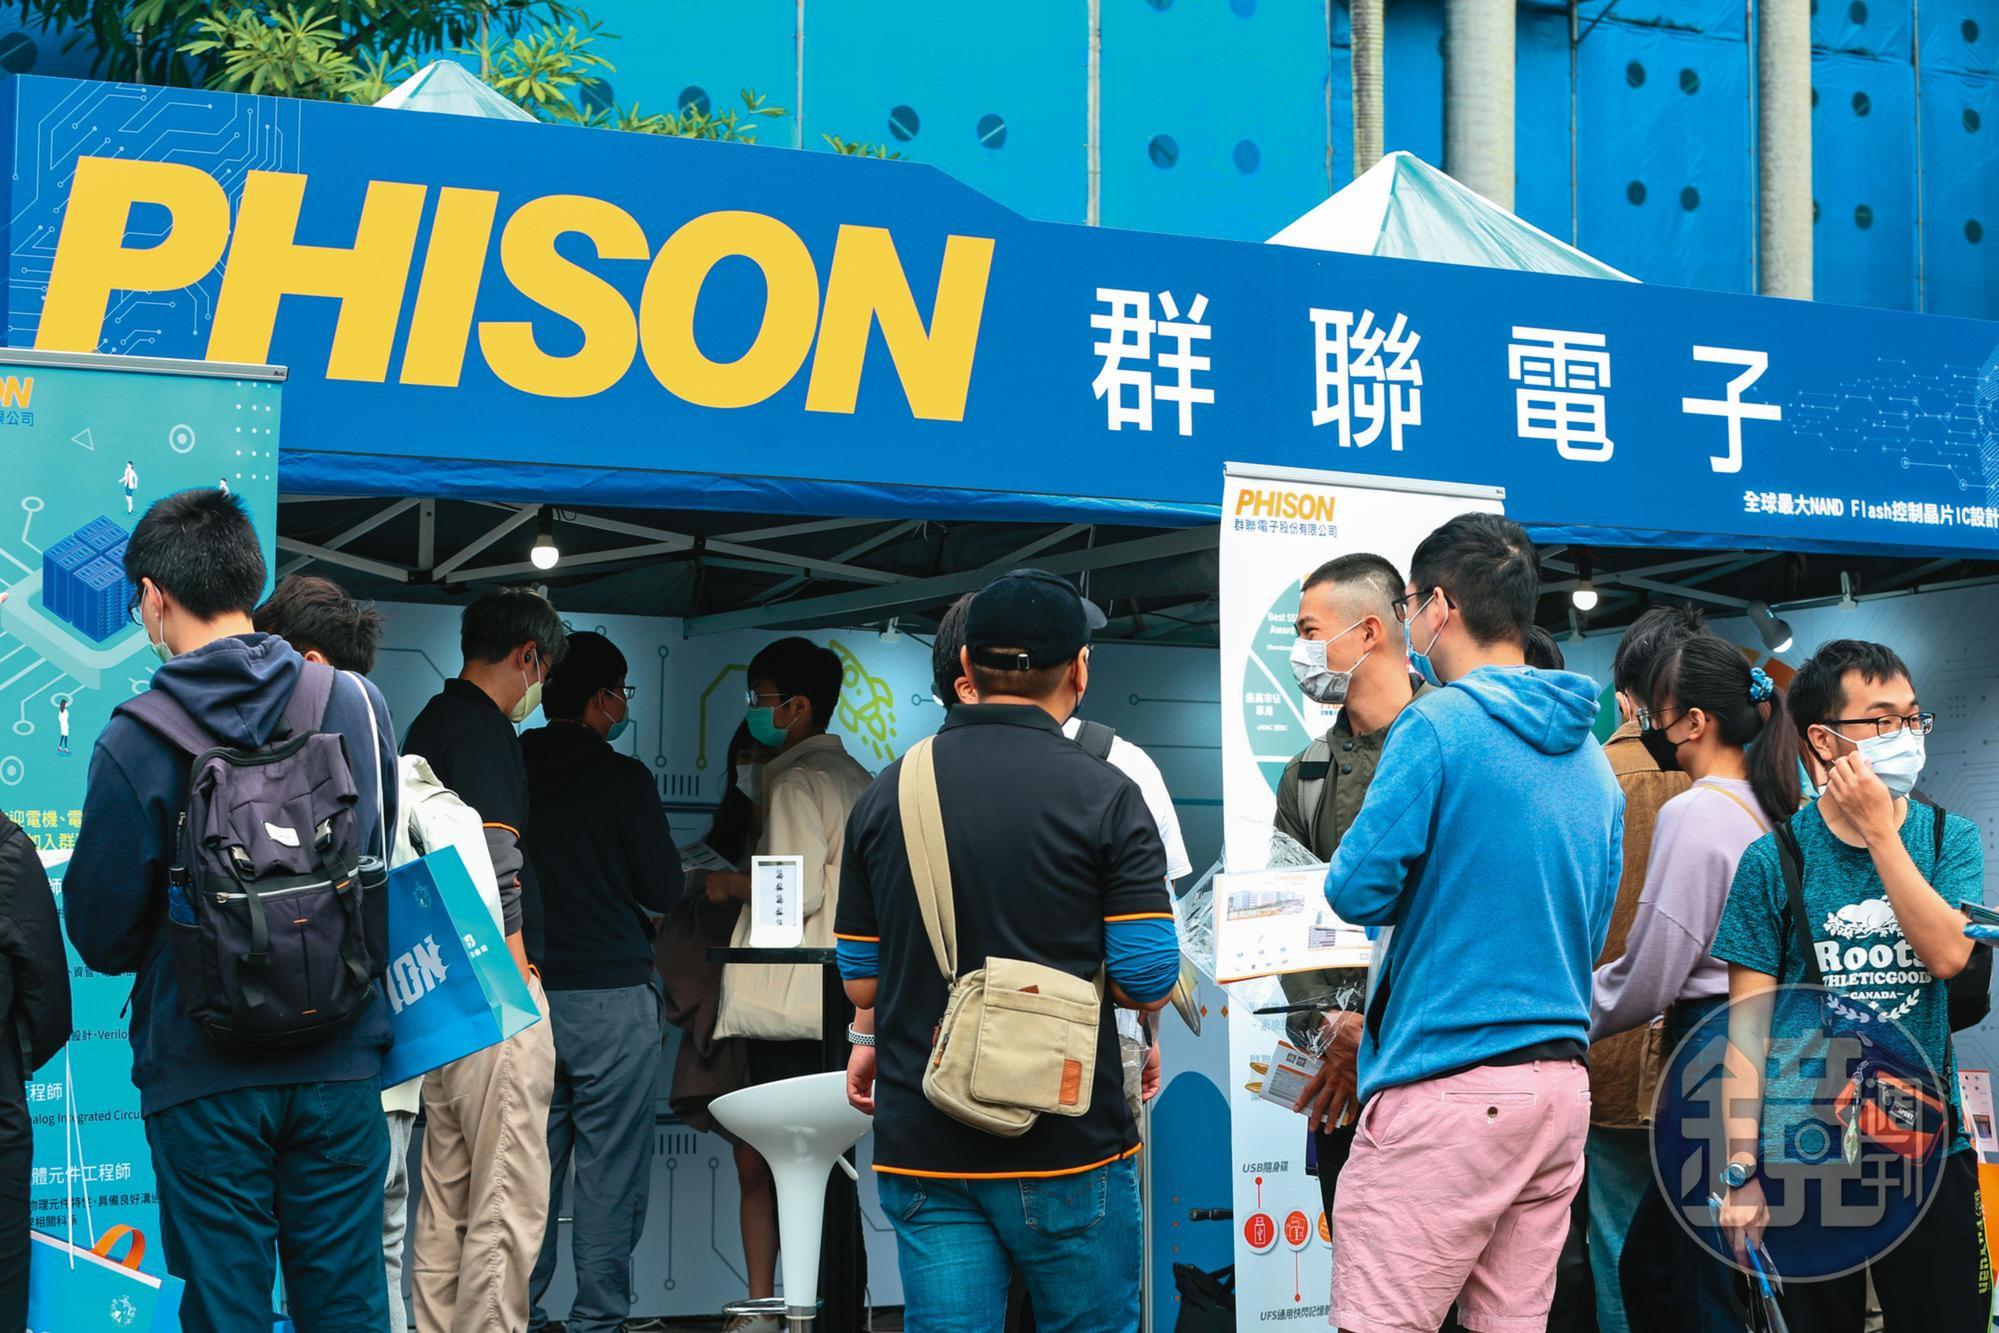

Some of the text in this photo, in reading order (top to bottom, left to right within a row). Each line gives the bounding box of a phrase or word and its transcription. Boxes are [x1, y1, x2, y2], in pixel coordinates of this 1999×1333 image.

[34, 156, 995, 422] PHISON
[1090, 287, 1782, 474] 群聯電子
[1235, 489, 1335, 521] PHISON
[1743, 490, 1844, 517] 全球最大NAND
[1234, 518, 1338, 538] 群聯電子股份有限公司
[3, 809, 82, 828] 迎電機、電
[1850, 991, 1897, 1000] CANADA
[31, 1162, 132, 1186] 體元件工程師
